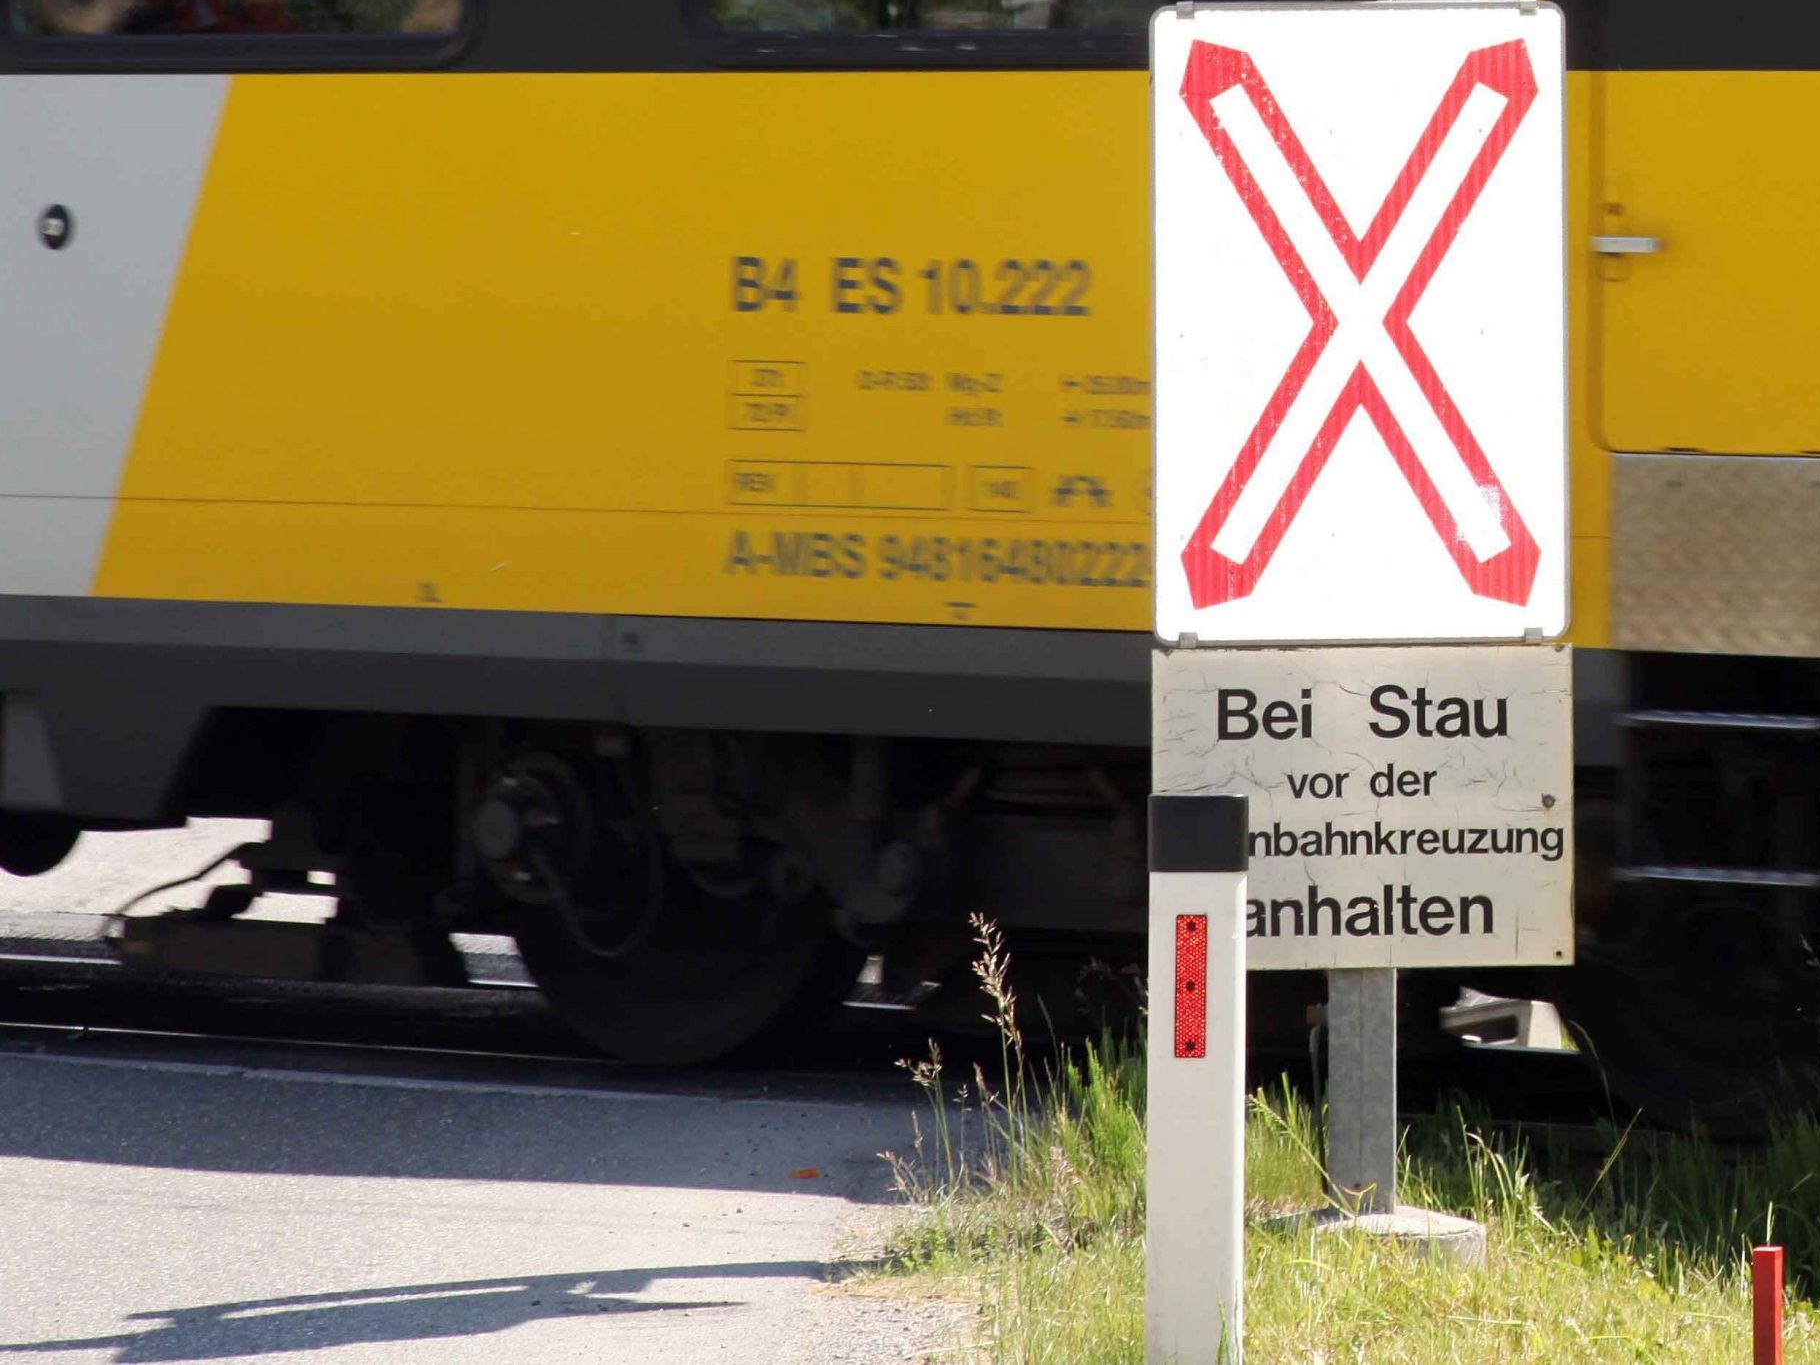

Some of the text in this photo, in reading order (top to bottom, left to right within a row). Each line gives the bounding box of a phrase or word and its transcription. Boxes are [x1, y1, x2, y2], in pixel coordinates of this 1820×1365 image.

[732, 255, 1093, 316] B4 ES 10.222
[724, 530, 868, 580] A-MBS
[1217, 684, 1508, 741] Bei Stau
[1286, 762, 1438, 799] vor der
[1248, 820, 1565, 861] nbahnkreuzung
[1246, 883, 1495, 938] anhalten
